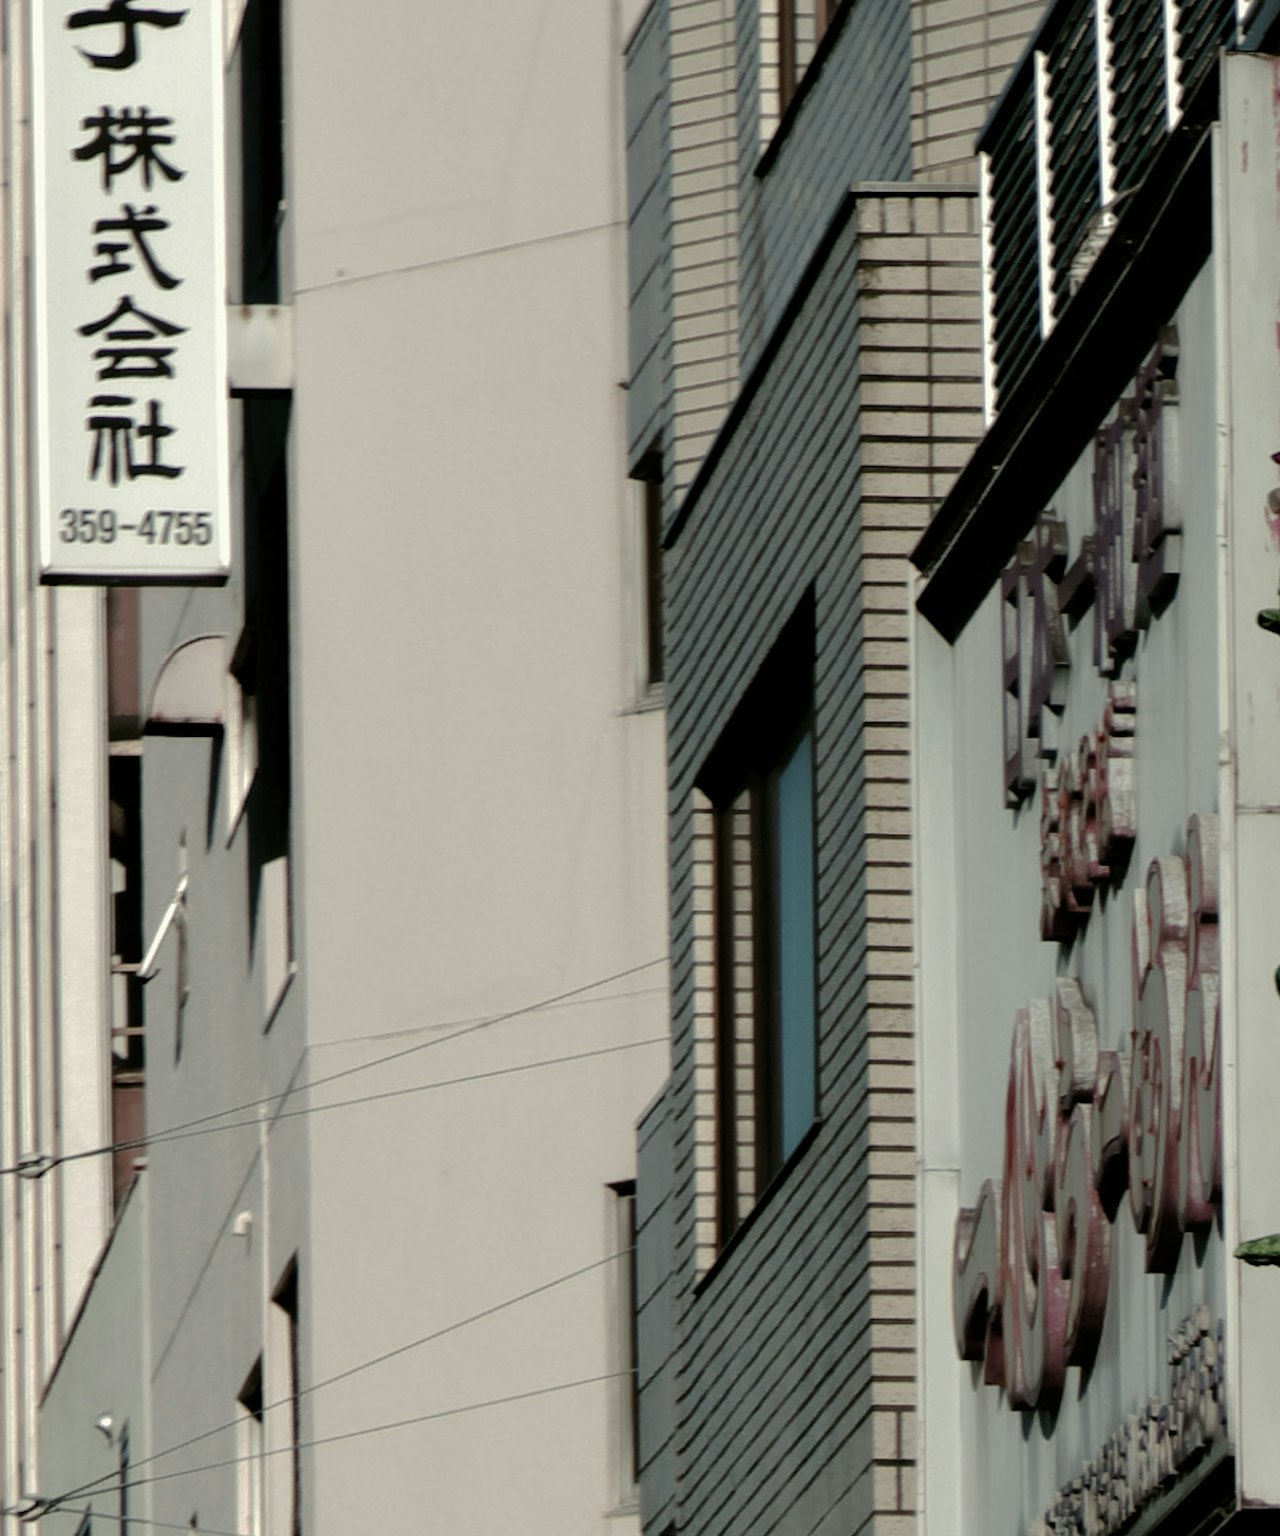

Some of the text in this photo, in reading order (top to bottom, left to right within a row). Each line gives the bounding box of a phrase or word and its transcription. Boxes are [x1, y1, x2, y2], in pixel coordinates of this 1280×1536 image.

[66, 0, 189, 486] 子株式会社
[59, 508, 214, 547] 359-4755
